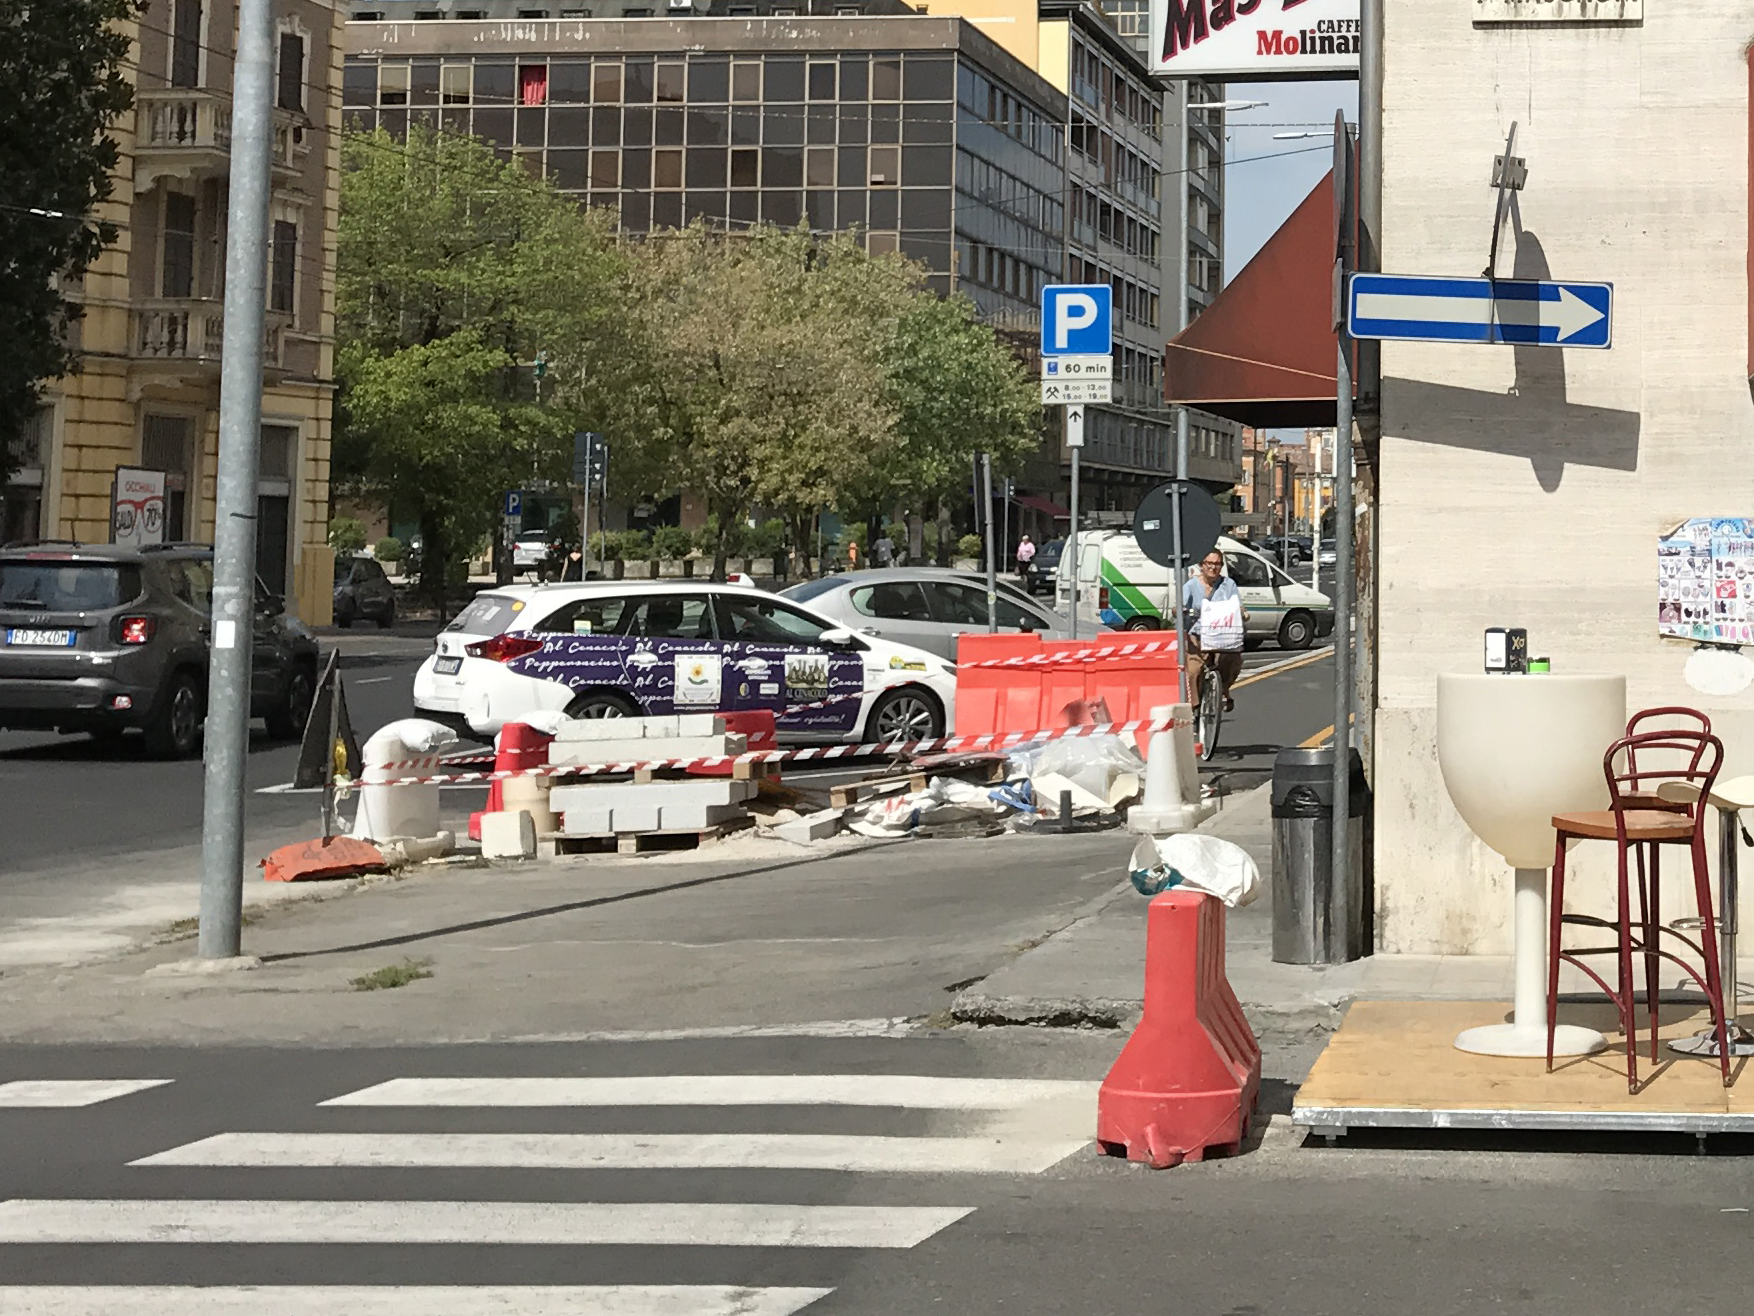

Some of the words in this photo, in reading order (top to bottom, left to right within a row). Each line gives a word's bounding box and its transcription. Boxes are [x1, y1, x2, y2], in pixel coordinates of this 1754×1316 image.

[1055, 293, 1098, 349] P
[1065, 364, 1081, 373] 60
[1085, 363, 1107, 373] min
[509, 494, 520, 513] P
